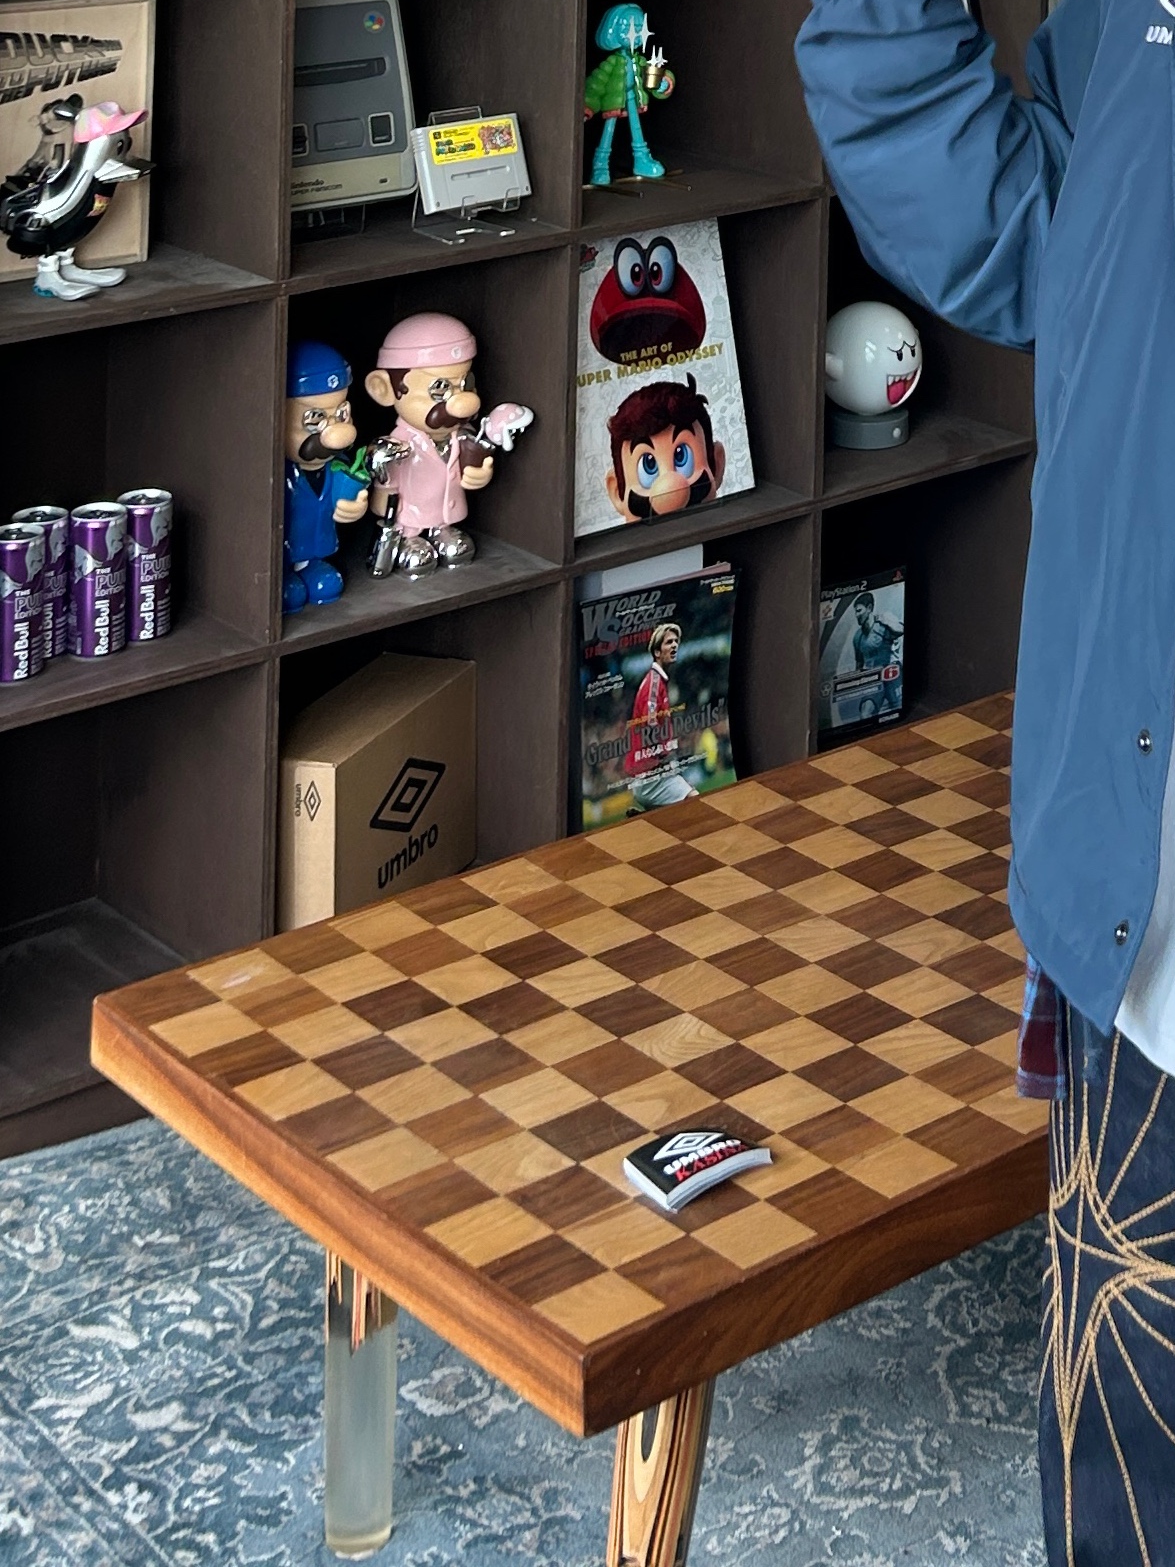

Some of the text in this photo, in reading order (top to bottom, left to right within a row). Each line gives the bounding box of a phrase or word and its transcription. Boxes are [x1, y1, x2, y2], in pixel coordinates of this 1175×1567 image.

[617, 357, 662, 379] MARIO
[666, 342, 724, 366] ODYSSEY
[620, 342, 673, 362] THE ART OF
[94, 599, 110, 656] Red Bull
[139, 584, 155, 640] Red Bull
[13, 621, 30, 681] Red Bull
[586, 729, 631, 767] Grand
[294, 783, 303, 818] umbro
[377, 822, 439, 890] umbro
[663, 1137, 742, 1176] UMBRO
[674, 1142, 750, 1183] KASINA
